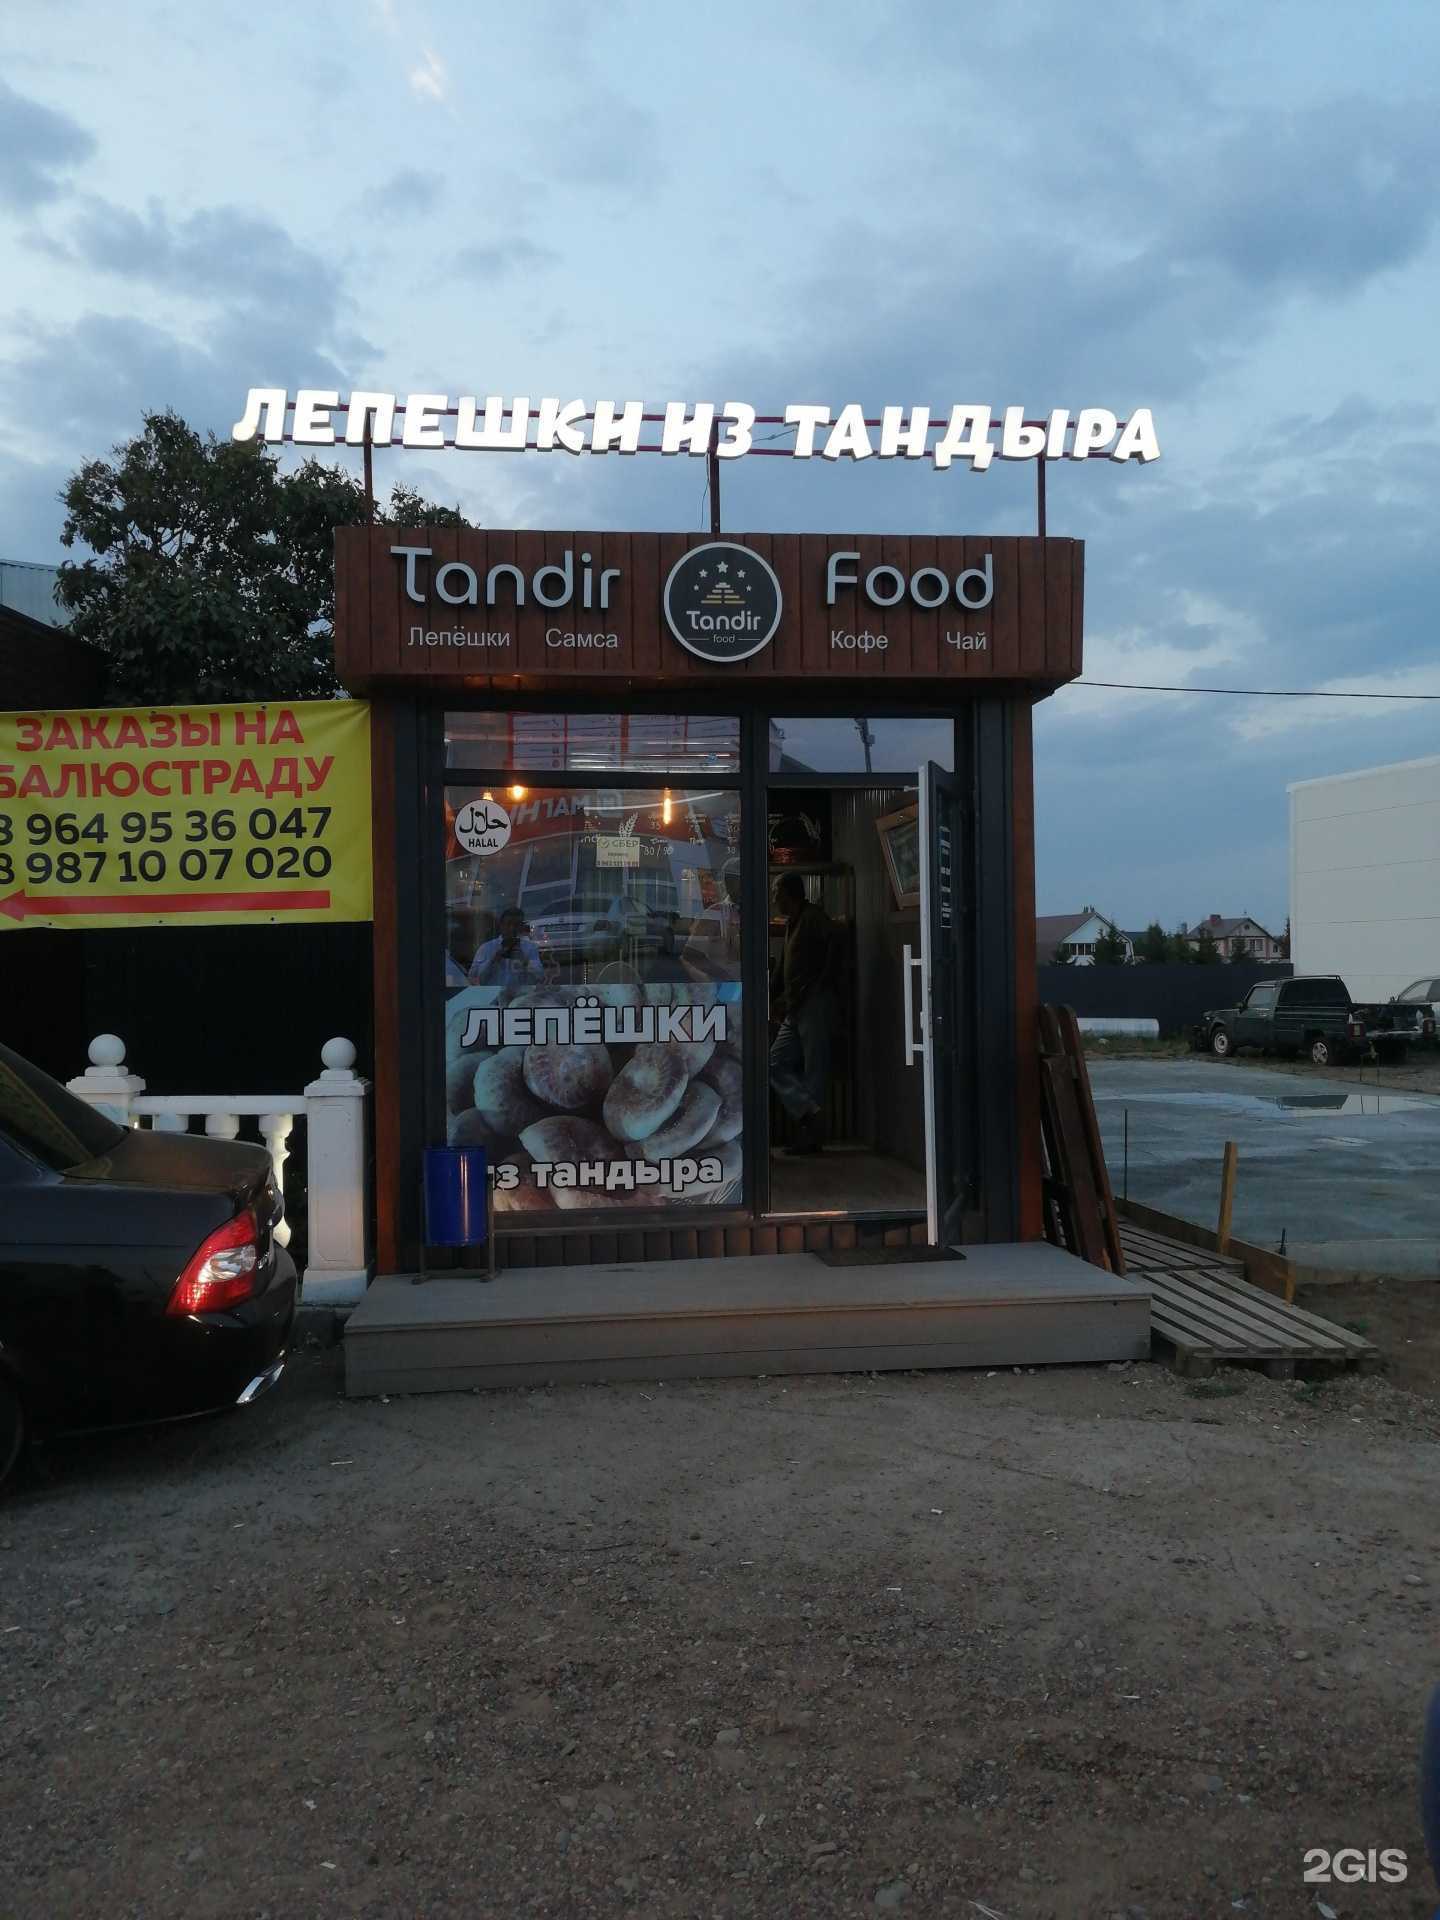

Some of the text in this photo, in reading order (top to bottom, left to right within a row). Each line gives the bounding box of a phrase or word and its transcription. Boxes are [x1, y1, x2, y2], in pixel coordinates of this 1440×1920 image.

[232, 388, 1161, 472] ЛЕПЕШКИ ИЗ ТАНДЫРА
[390, 545, 620, 609] Tandir
[826, 551, 994, 609] Food
[408, 626, 618, 649] Лепёшки Самса
[686, 610, 761, 631] Tandir
[713, 634, 735, 643] food
[831, 630, 987, 653] Кофе Чай
[16, 710, 304, 752] ЗАКАЗЫ НА
[26, 813, 109, 845] 964
[120, 811, 173, 844] 95
[184, 809, 237, 842] 36
[249, 807, 332, 840] 047
[459, 805, 508, 835] حلال
[468, 838, 499, 848] HALAL
[611, 839, 639, 848] СБЕР
[25, 851, 107, 884] 987
[118, 850, 166, 883] 10
[179, 848, 233, 881] 07
[245, 846, 332, 879] 020
[460, 996, 727, 1048] ЛЕПЁШКИ
[531, 1155, 723, 1192] тандыра
